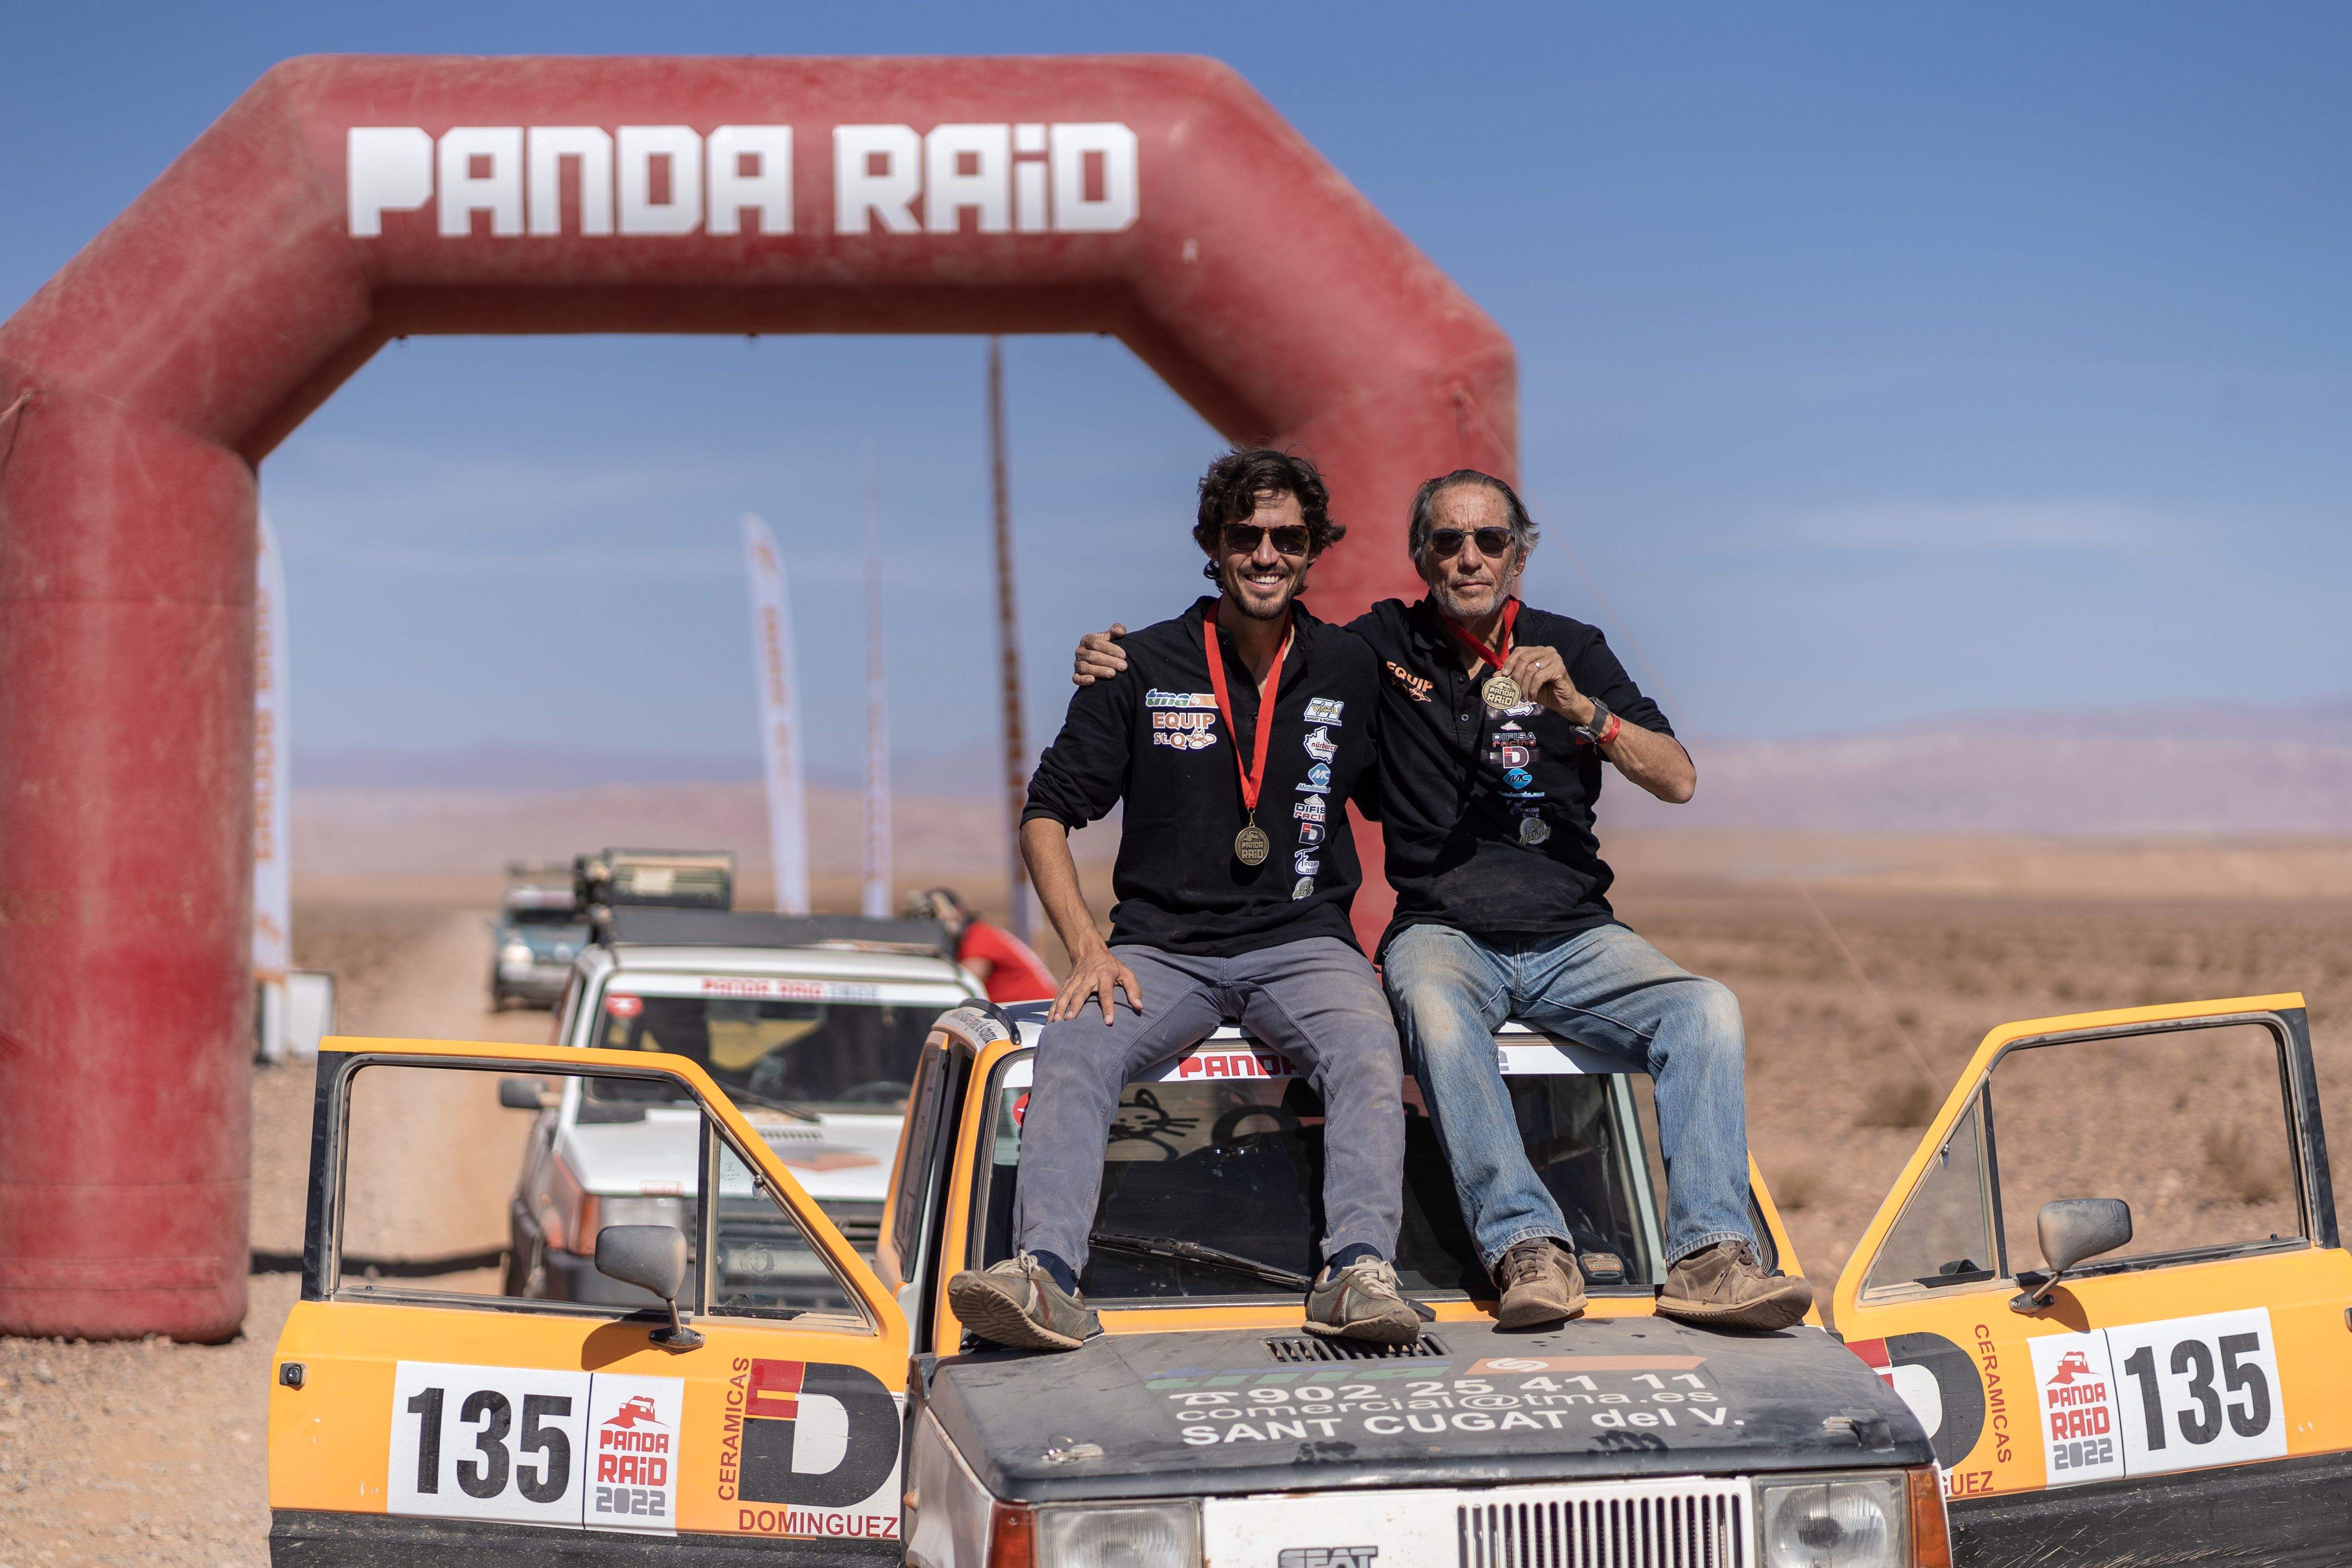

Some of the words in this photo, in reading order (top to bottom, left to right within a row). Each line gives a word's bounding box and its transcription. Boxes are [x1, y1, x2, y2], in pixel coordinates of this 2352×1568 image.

[347, 124, 794, 237] PANDA
[1489, 687, 1515, 698] PANDA
[1153, 712, 1216, 730] EQUIP
[1492, 732, 1536, 741] DIFISA
[1507, 774, 1530, 782] MC
[1248, 1384, 1382, 1404] 902
[1405, 1378, 1494, 1397] 25
[1519, 1375, 1598, 1392] 41
[1631, 1373, 1707, 1389] 11
[1975, 1324, 2012, 1463] CERAMICAS
[2047, 1383, 2107, 1409] PANDA
[2124, 1331, 2271, 1451] 135
[1176, 1390, 1719, 1421] comercial@tma.es
[599, 1429, 669, 1454] PANDA
[718, 1357, 750, 1501] CERAMICAS
[1181, 1417, 1342, 1446] SANT
[1364, 1410, 1569, 1435] CUGAT
[1590, 1408, 1677, 1428] del
[1687, 1406, 1746, 1426] V.
[407, 1387, 571, 1503] 135
[2054, 1438, 2113, 1470] 2022
[596, 1486, 665, 1517] 2022
[739, 1509, 898, 1539] DOMINGUEZ
